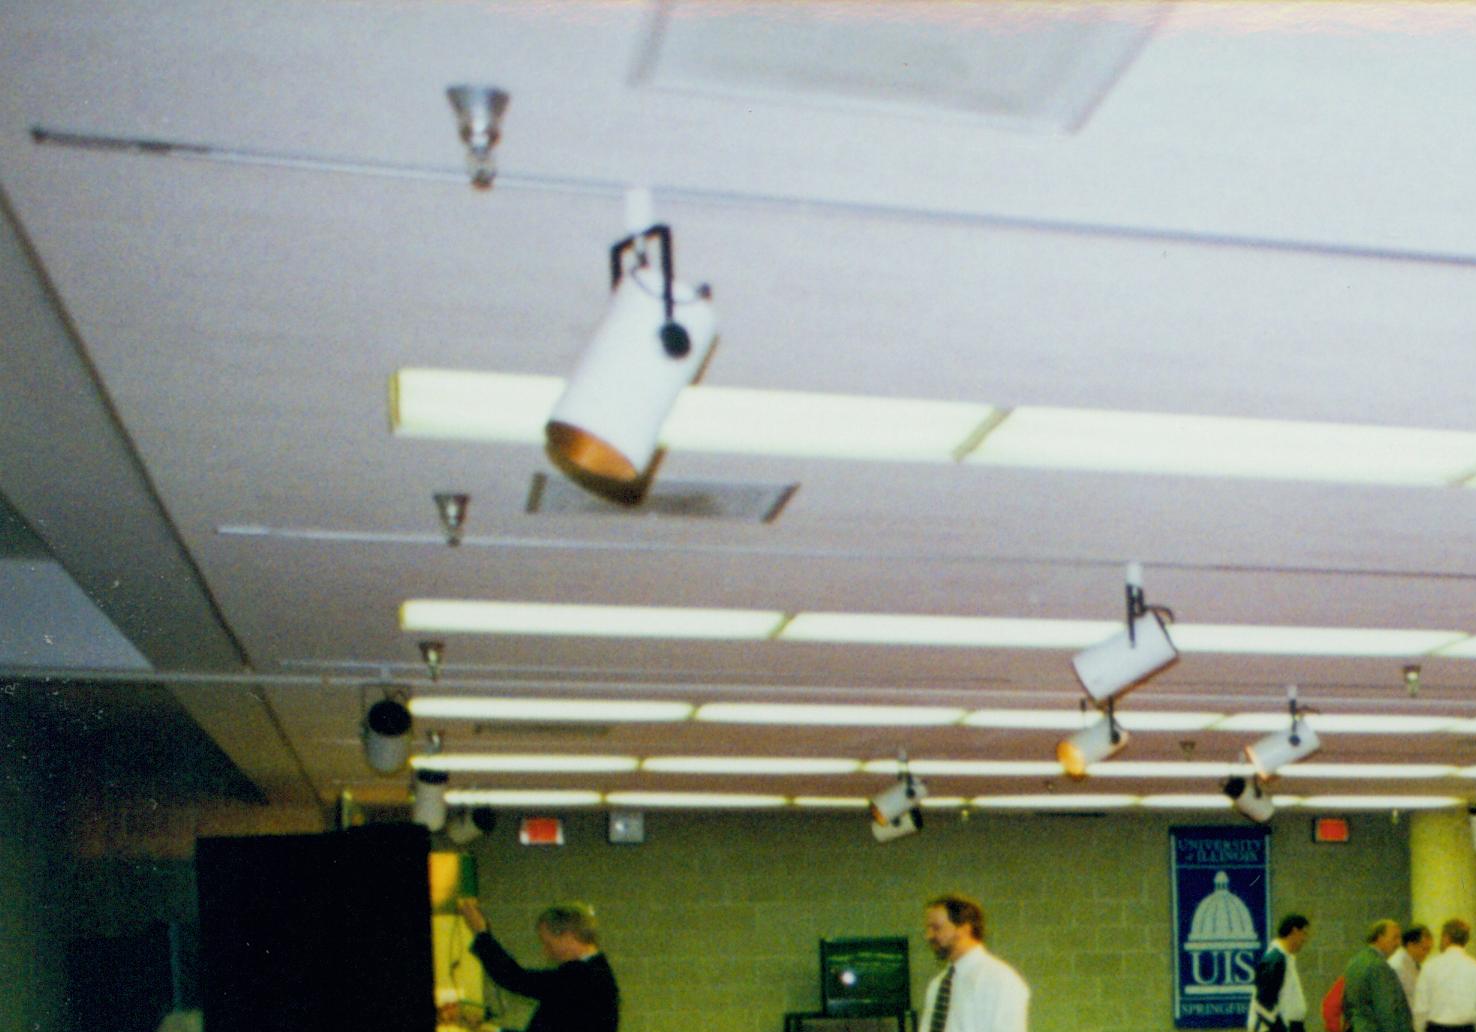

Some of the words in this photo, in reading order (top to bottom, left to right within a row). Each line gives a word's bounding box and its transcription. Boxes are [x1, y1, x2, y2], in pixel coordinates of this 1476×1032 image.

[1178, 839, 1262, 850] UNIVERSITY
[1197, 850, 1258, 861] ILLINOIS
[1190, 950, 1256, 985] UIS
